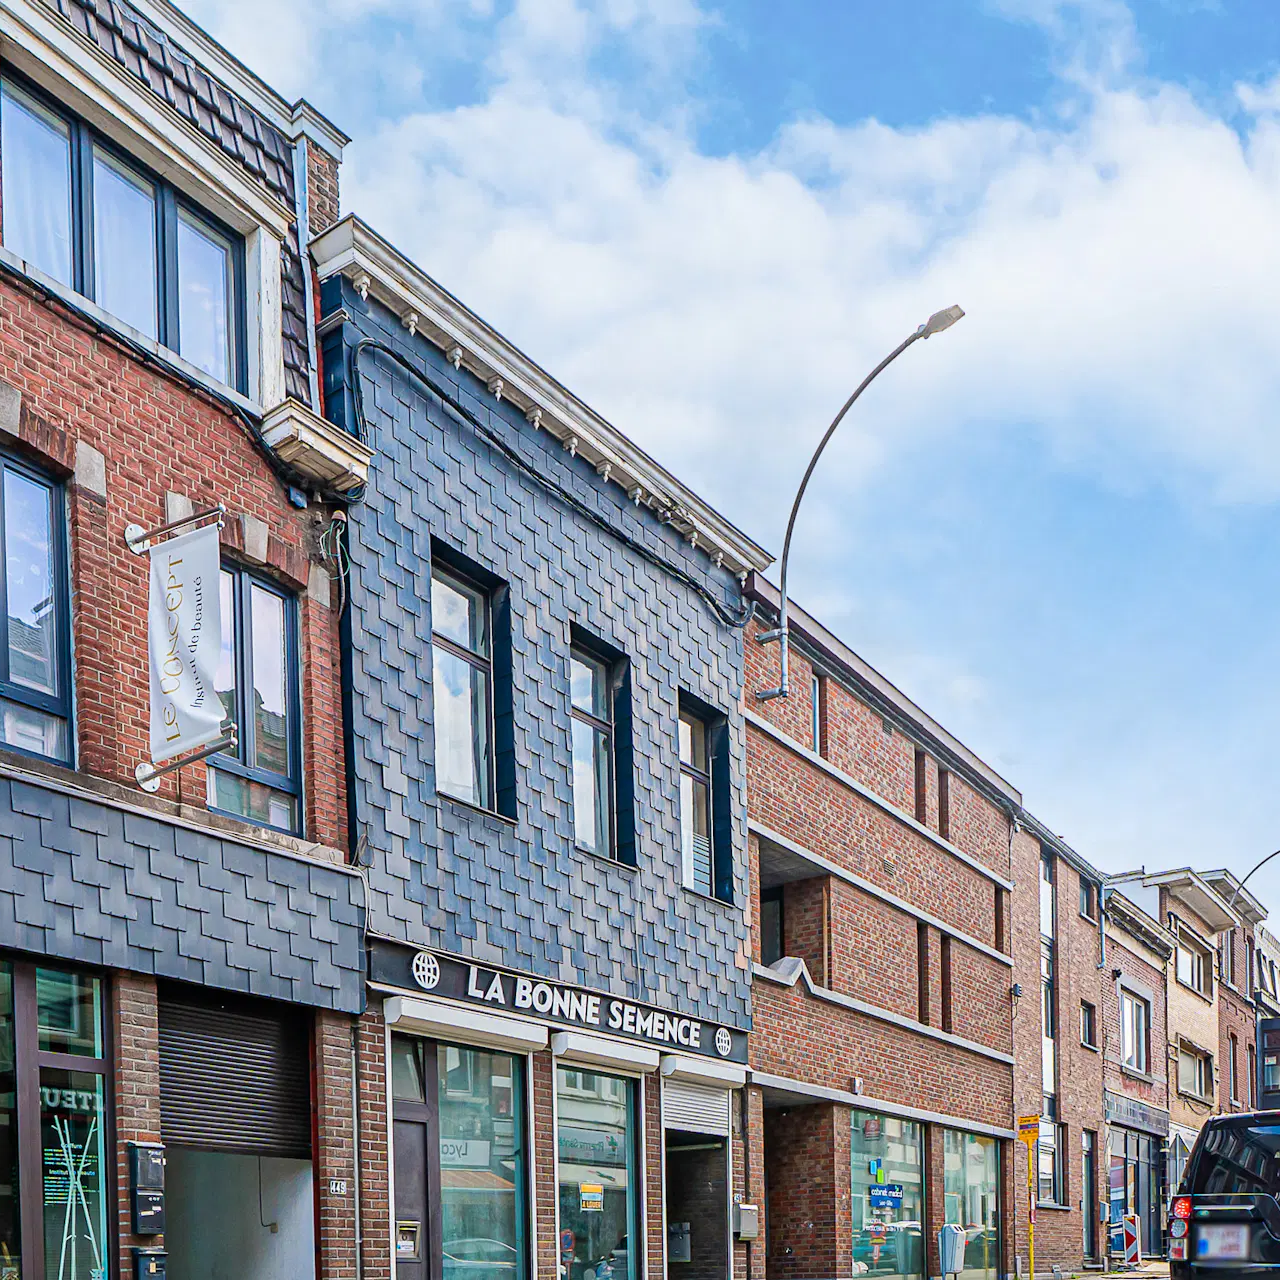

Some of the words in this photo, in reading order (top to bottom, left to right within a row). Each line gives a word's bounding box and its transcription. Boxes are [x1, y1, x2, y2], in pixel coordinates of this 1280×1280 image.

[160, 554, 184, 695] CONCEPT
[190, 576, 203, 631] beauté
[187, 635, 200, 653] de
[163, 702, 181, 742] LE
[467, 966, 506, 1005] LA
[514, 977, 601, 1026] BONNE
[607, 999, 702, 1049] SEMENCE
